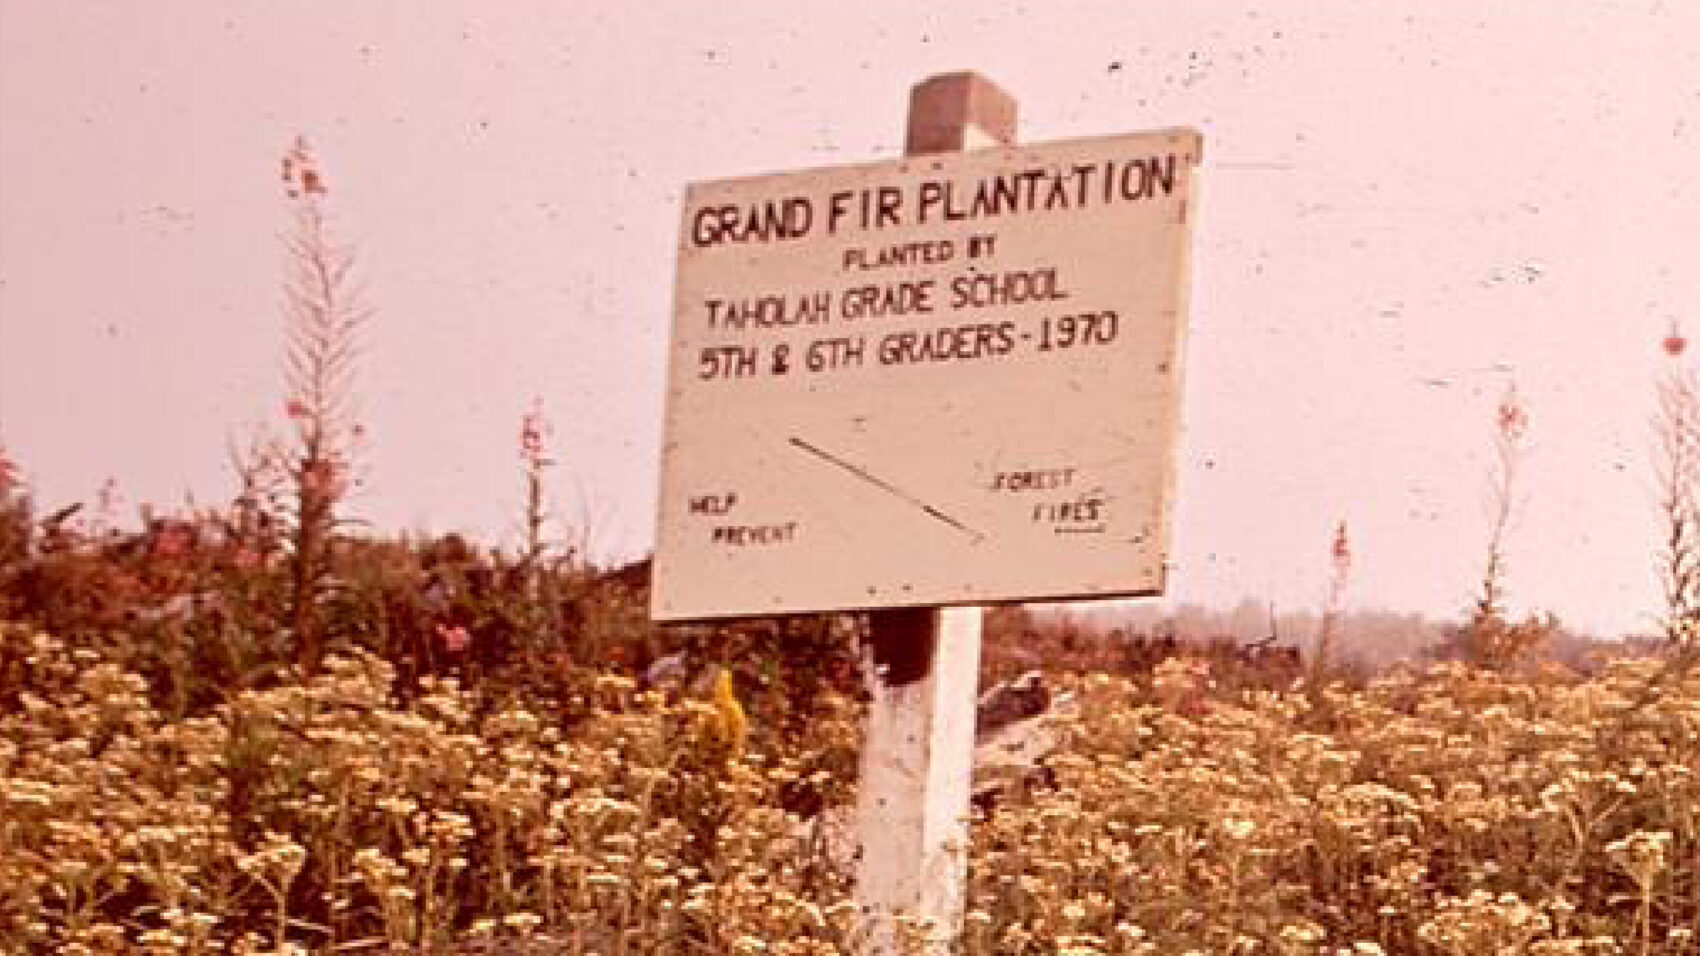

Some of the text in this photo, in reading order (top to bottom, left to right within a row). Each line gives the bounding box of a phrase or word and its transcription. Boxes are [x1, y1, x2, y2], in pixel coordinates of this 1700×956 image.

[691, 154, 1178, 247] GRAND FIR PLANTATION
[842, 234, 998, 271] PLANTED BY
[705, 268, 1068, 329] TAHOLAH GRADE SCHOOL
[699, 346, 756, 380] 5TH
[771, 344, 789, 375] &
[806, 337, 864, 373] 6TH
[993, 469, 1076, 491] FOREST
[688, 492, 736, 514] HELP
[1033, 499, 1103, 523] FIRES
[711, 522, 797, 546] PREVENT
